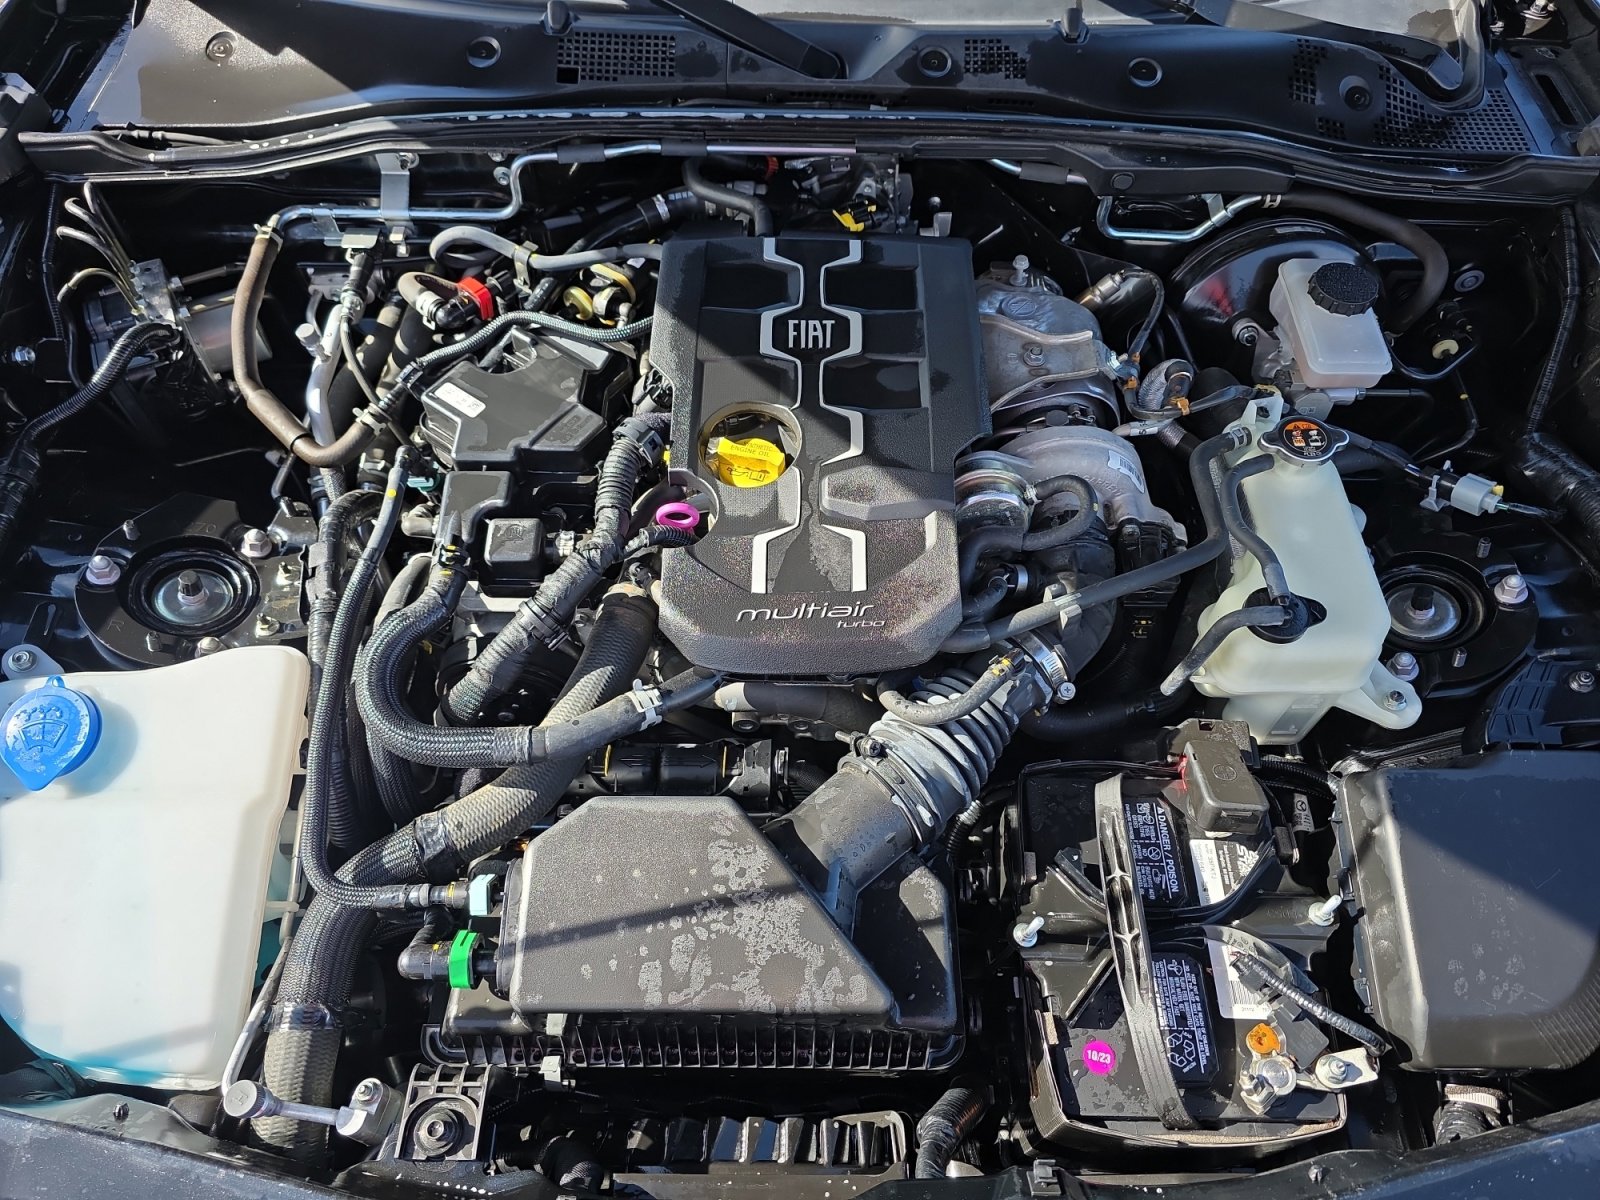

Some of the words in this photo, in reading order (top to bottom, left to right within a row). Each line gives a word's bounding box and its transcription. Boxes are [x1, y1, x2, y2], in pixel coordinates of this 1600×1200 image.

[788, 319, 835, 349] FIAT
[730, 445, 757, 455] ENGINE
[758, 450, 770, 458] OIL
[735, 601, 875, 622] multiair
[837, 618, 886, 629] turbo
[1158, 816, 1171, 850] DANGER
[1166, 860, 1179, 892] POISON
[1086, 1049, 1111, 1065] 10/23
